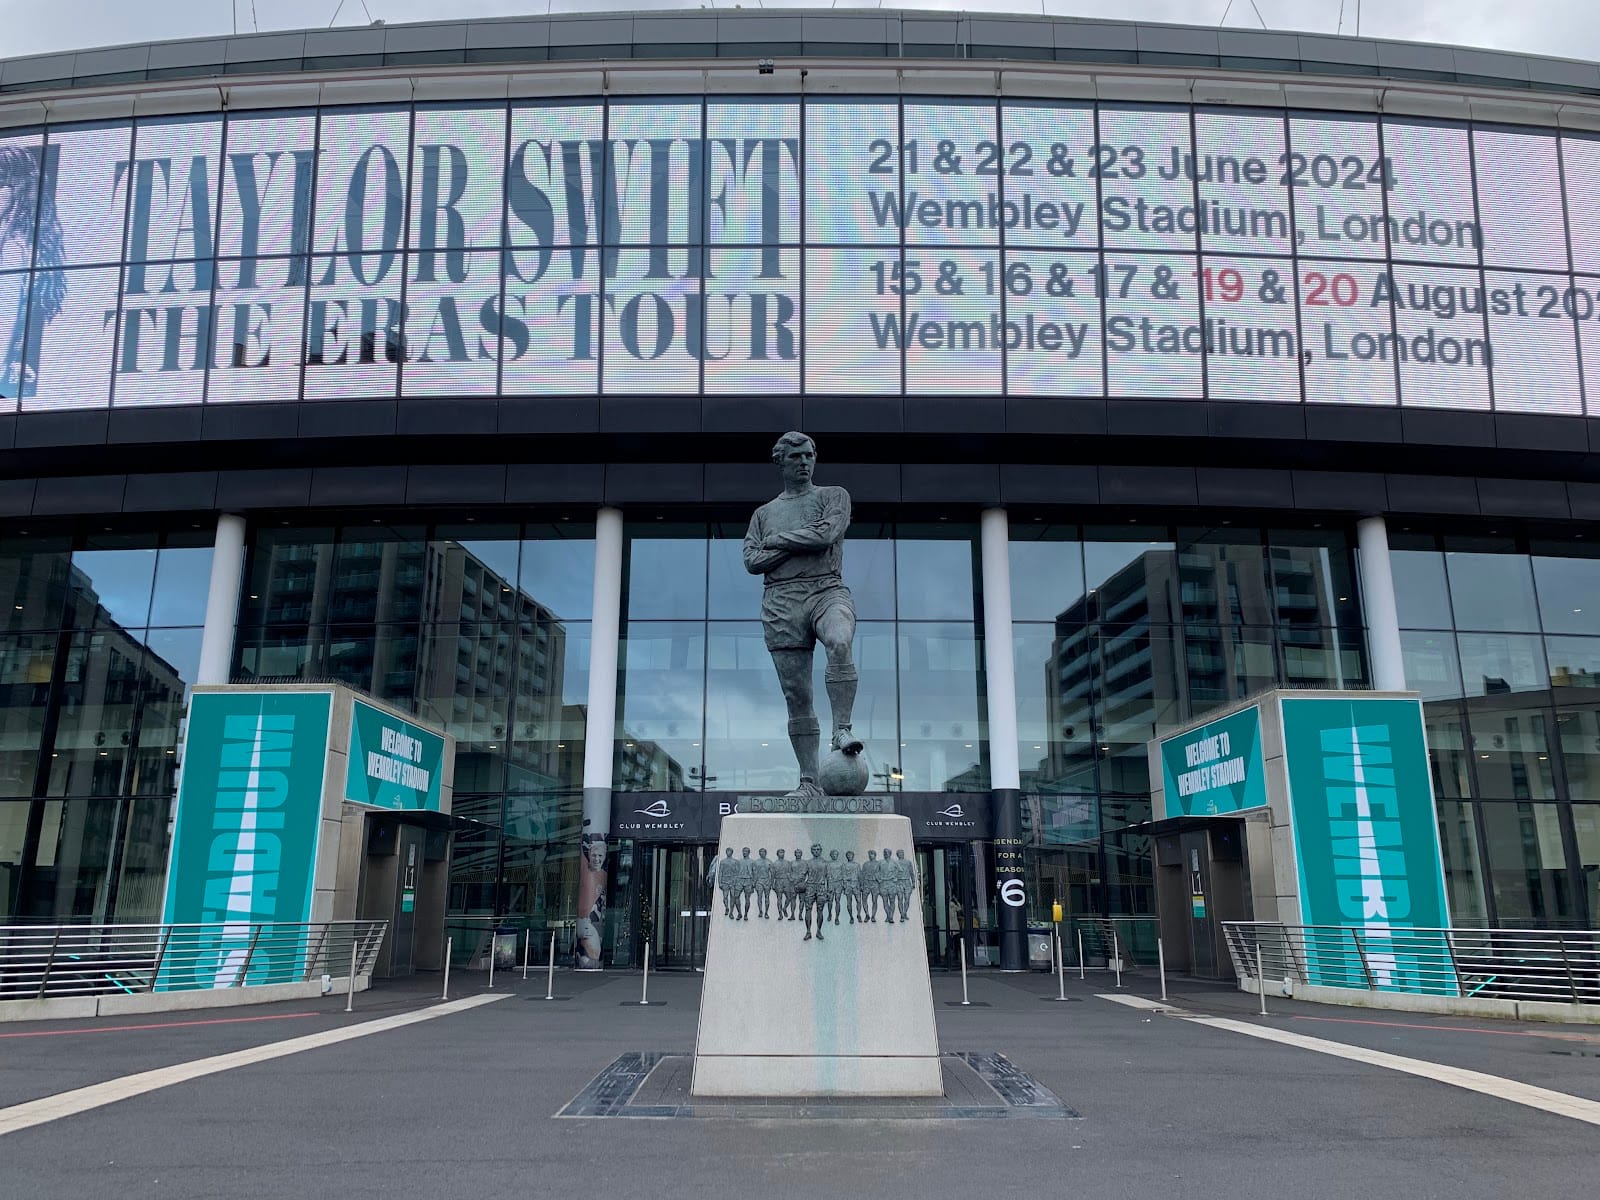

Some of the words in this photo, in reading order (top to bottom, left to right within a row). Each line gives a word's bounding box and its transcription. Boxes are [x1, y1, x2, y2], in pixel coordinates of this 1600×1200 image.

[868, 139, 918, 175] 21
[933, 139, 963, 176] &
[975, 141, 1034, 177] 22
[1046, 142, 1076, 178] &
[1087, 144, 1147, 180] 23
[1158, 146, 1267, 185] June
[1278, 153, 1399, 192] 2024
[111, 143, 474, 294] TAYLOR
[505, 138, 799, 283] SWIFT
[867, 191, 1085, 238] Wembley
[1102, 196, 1305, 247] Stadium,
[1316, 204, 1484, 249] London
[869, 261, 922, 296] 15
[934, 261, 964, 296] &
[978, 261, 1034, 297] 16
[1045, 263, 1076, 298] &
[1087, 263, 1138, 299] 17
[1150, 265, 1180, 300] &
[1192, 267, 1245, 302] 19
[1257, 269, 1288, 305] &
[1302, 271, 1360, 307] 20
[1369, 271, 1529, 320] August
[1536, 284, 1600, 321] 20
[103, 302, 272, 374] THE
[299, 293, 530, 367] ERAS
[556, 292, 799, 361] TOUR
[868, 312, 1089, 360] Wembley
[1106, 315, 1313, 367] Stadium,
[1323, 322, 1494, 367] London
[381, 725, 415, 761] WELCOME
[414, 738, 423, 764] TO
[1185, 734, 1220, 768] WELCOME
[1218, 731, 1231, 757] TO
[367, 750, 402, 785] WEMBLEY
[401, 763, 430, 793] STADIUM
[1177, 766, 1210, 797] WEMBLEY
[1210, 755, 1246, 789] STADIUM
[751, 798, 811, 812] BOBBY
[816, 798, 884, 813] MOORE
